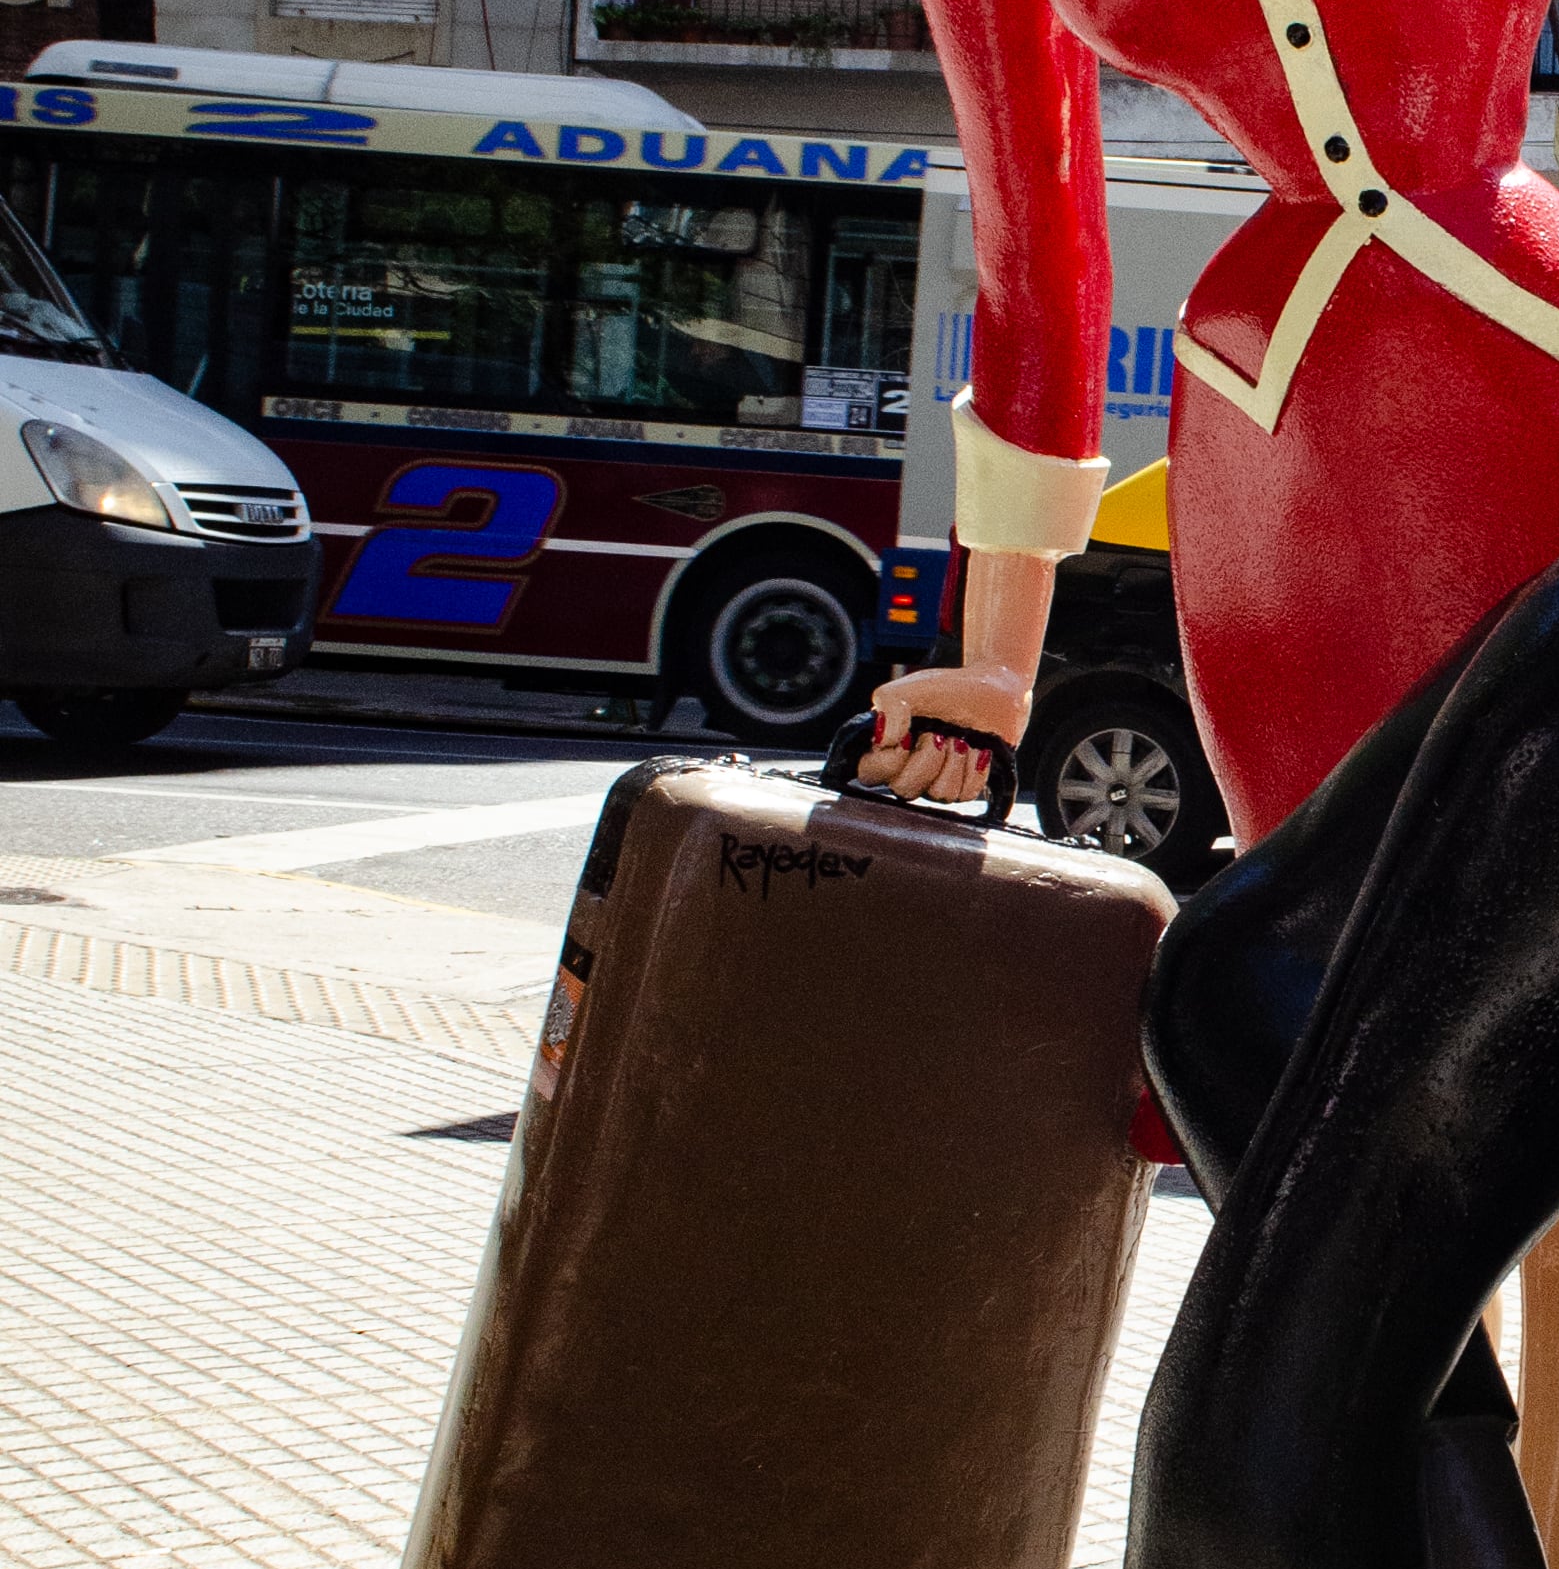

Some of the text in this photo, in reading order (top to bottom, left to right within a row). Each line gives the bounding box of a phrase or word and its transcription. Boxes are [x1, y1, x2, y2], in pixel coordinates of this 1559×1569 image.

[185, 102, 378, 145] 2
[472, 120, 928, 183] ADUANA
[335, 301, 394, 318] Ciudad
[317, 457, 567, 635] 2
